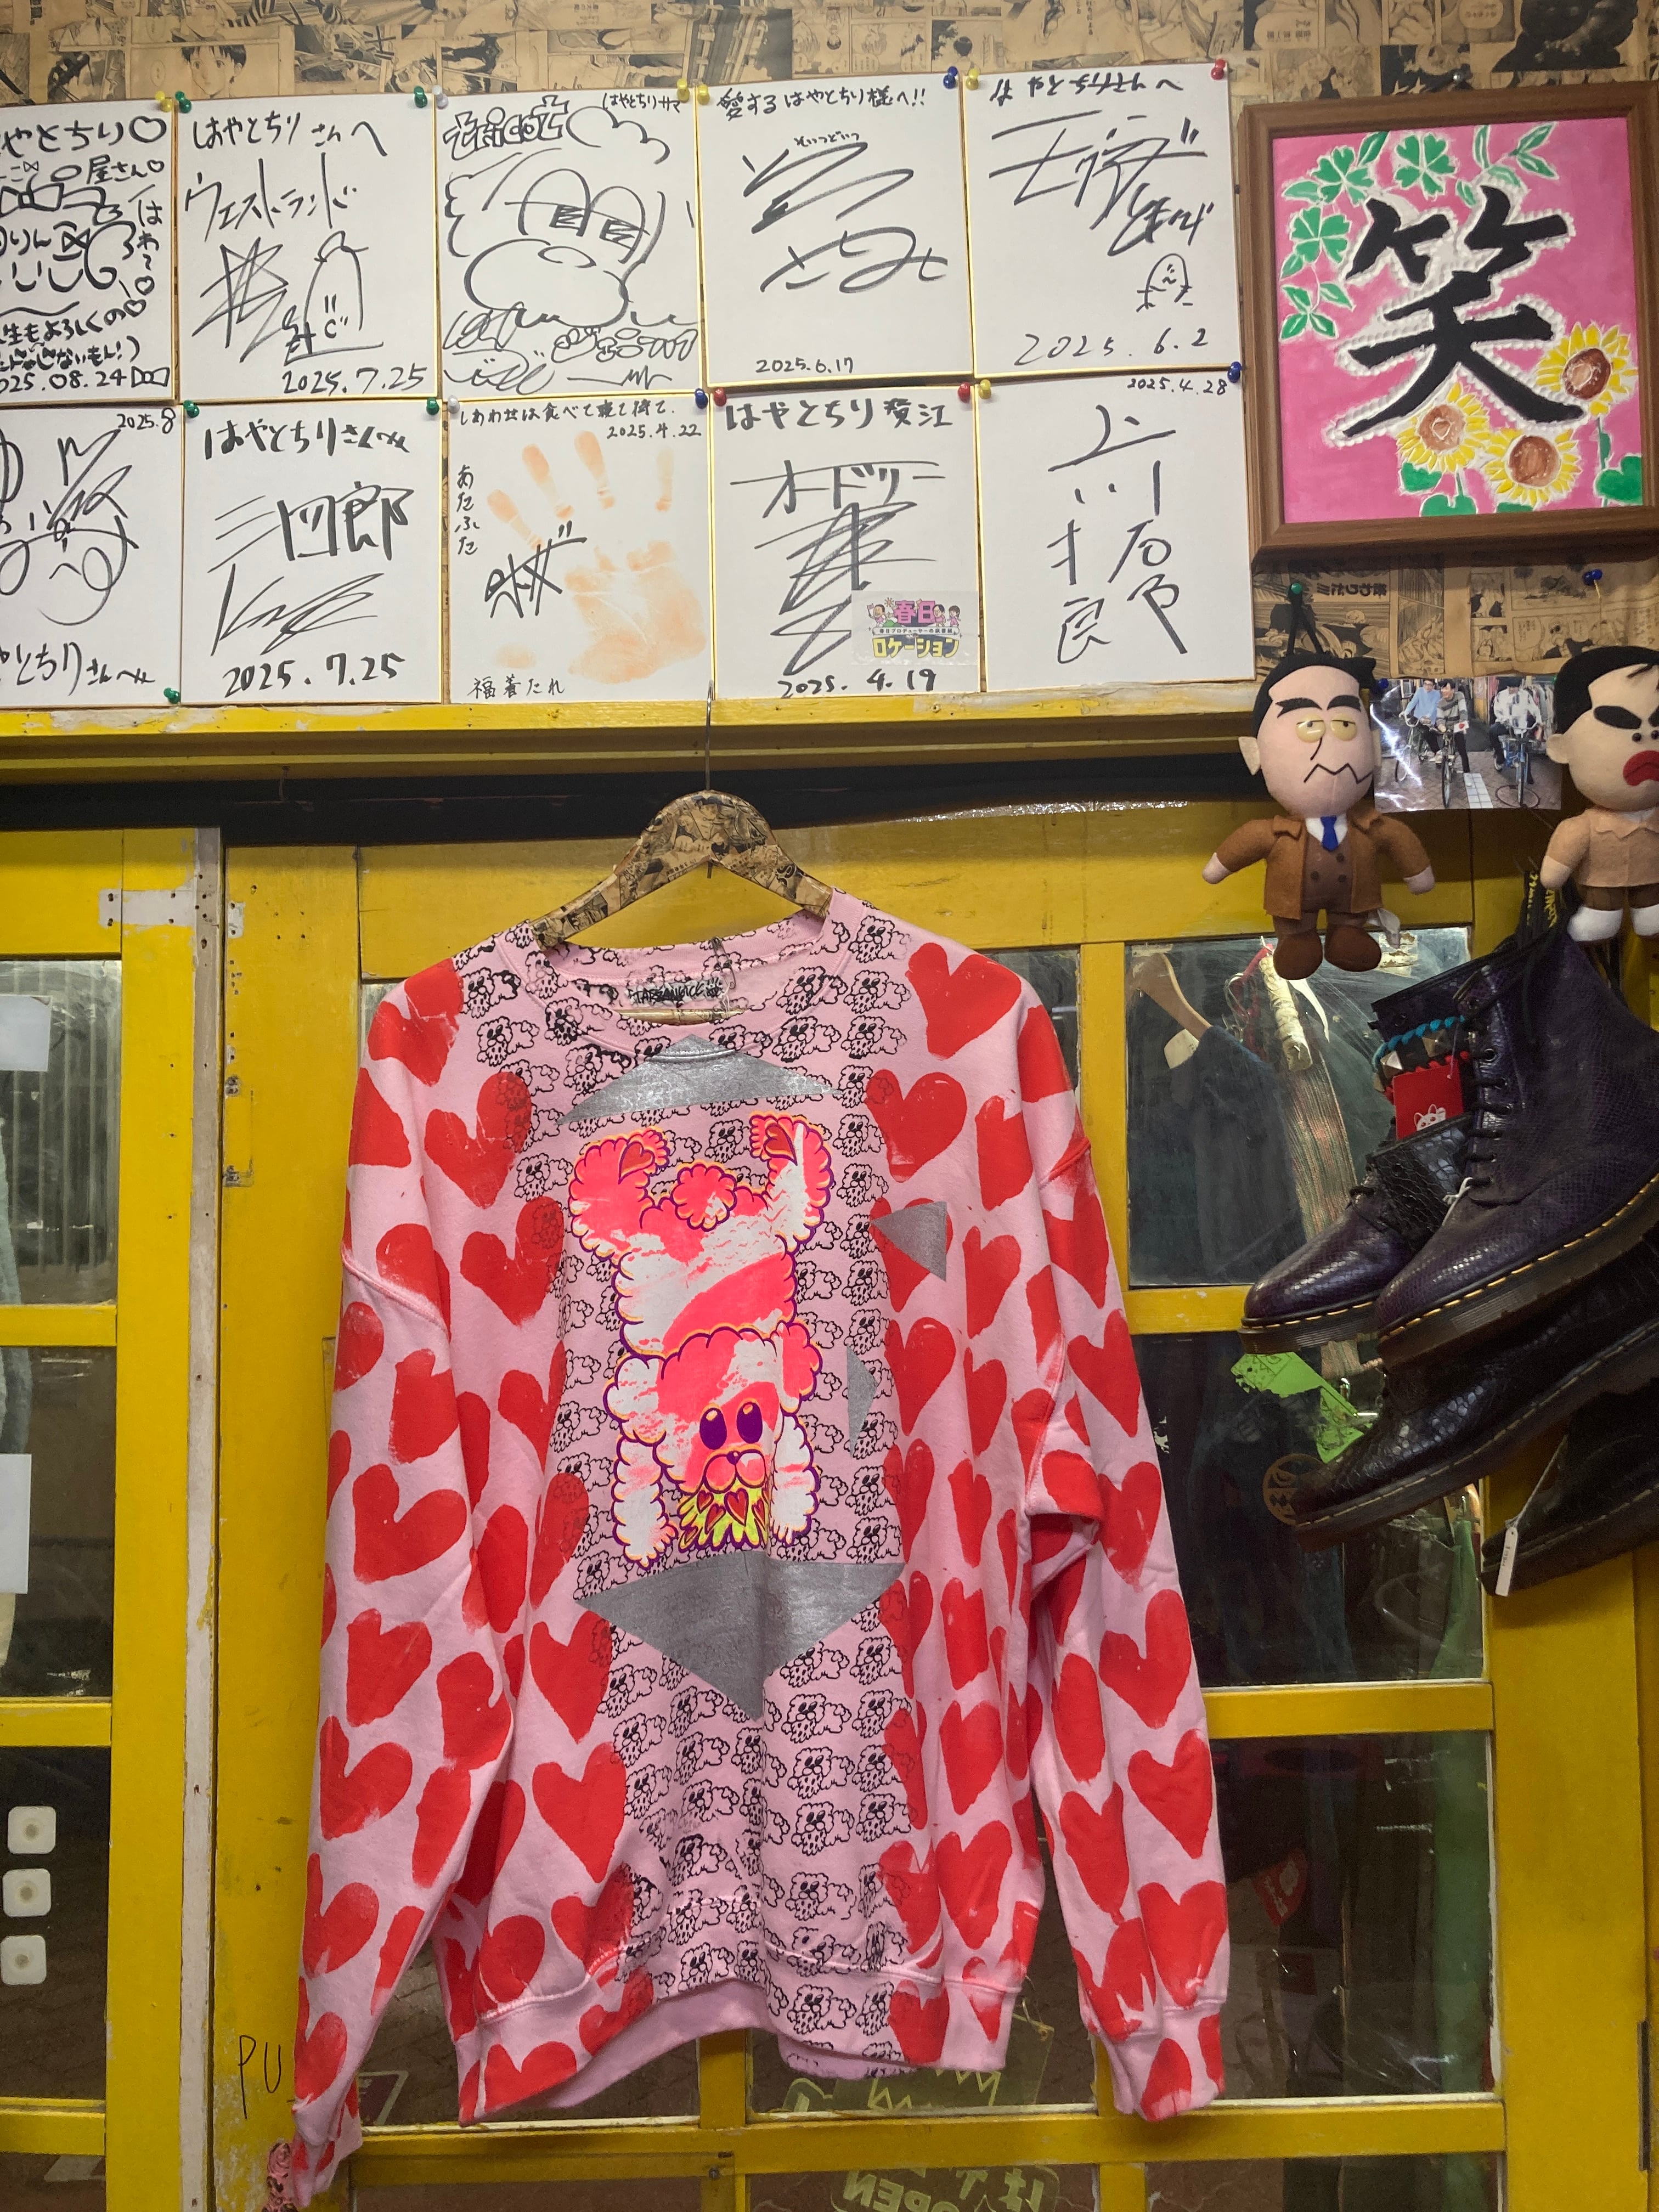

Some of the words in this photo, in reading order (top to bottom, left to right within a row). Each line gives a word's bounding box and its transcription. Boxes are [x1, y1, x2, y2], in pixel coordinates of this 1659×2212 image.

[1342, 184, 1584, 437] 笑
[756, 357, 854, 374] 2025.6.17
[282, 363, 427, 394] 2025.7.25
[1127, 379, 1227, 396] 2025.4.28
[117, 408, 176, 433] 2025.8
[607, 423, 701, 439] 2025.4.22
[730, 460, 946, 518] オードリー
[455, 465, 479, 555] あたふた
[894, 600, 936, 623] 春日
[872, 637, 959, 658] ロケーション
